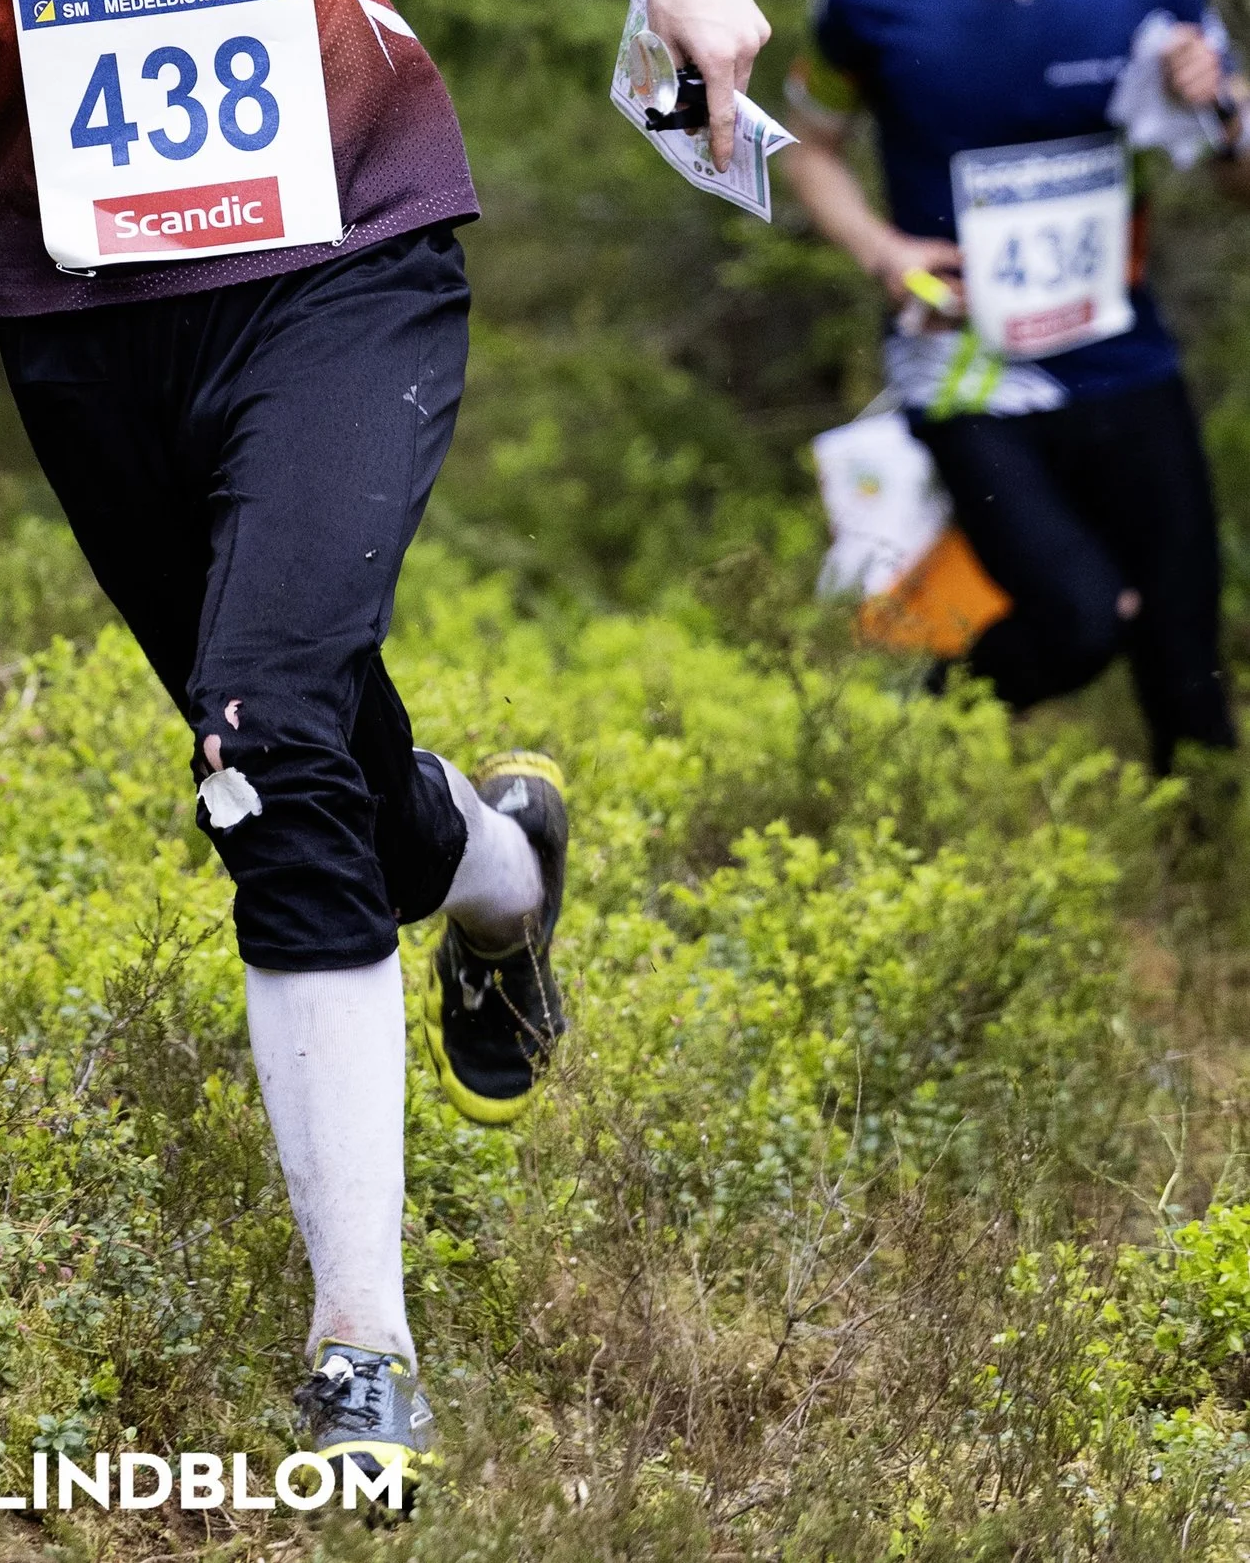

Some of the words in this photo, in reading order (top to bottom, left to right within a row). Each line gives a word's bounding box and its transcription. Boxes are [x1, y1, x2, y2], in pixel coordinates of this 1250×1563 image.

[62, 1, 90, 19] SM
[70, 35, 280, 167] 438
[114, 195, 264, 239] Scandic
